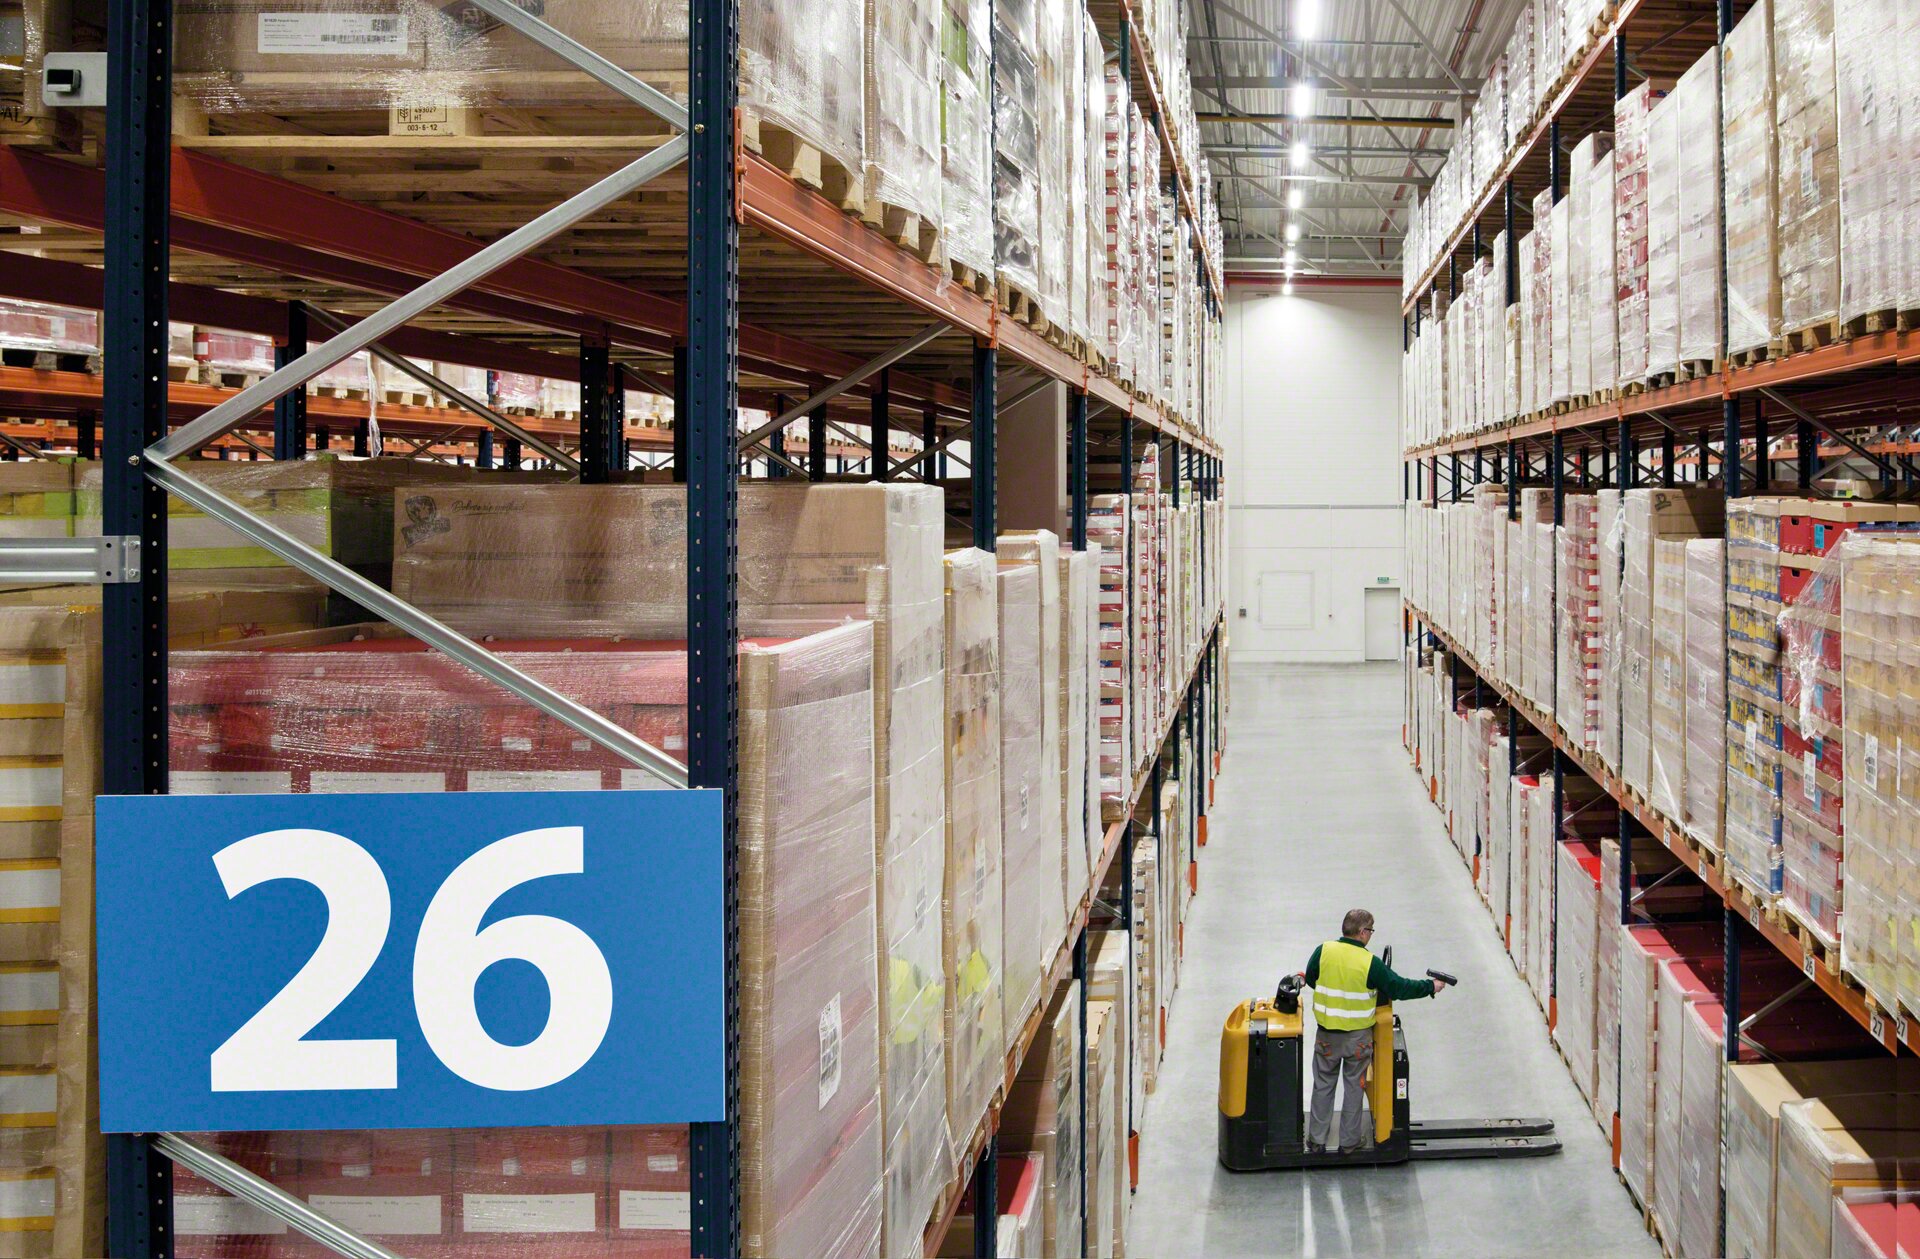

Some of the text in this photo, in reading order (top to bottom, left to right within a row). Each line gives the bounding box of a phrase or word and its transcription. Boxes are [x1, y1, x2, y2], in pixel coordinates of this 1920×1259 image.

[211, 827, 612, 1091] 26
[1805, 957, 1814, 976] 26
[1872, 1016, 1883, 1037] 27
